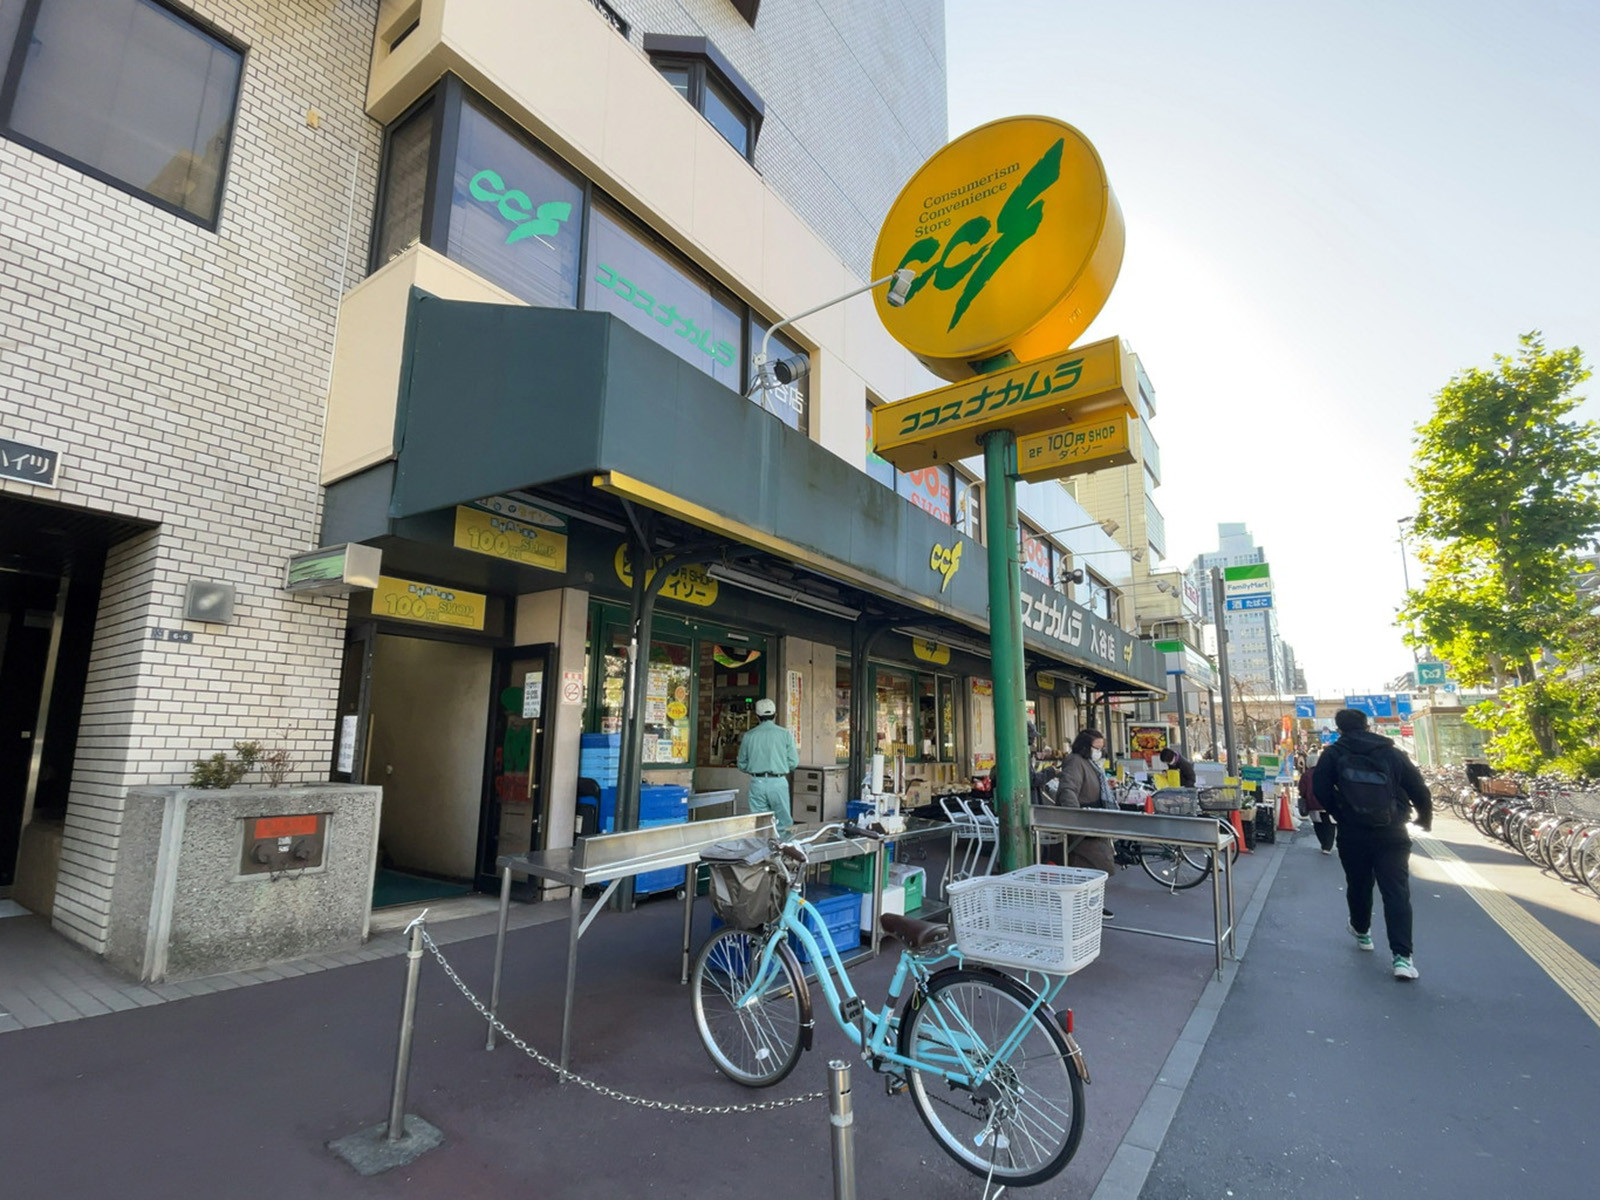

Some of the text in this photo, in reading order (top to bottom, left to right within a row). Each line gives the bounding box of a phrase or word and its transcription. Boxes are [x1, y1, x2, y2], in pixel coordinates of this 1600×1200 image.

[919, 182, 1007, 224] Convenience
[923, 162, 1020, 209] Consumerism
[915, 218, 951, 238] Store
[595, 263, 737, 368] ココスナカムラ
[899, 358, 1085, 435] ココスナカムラ
[1029, 425, 1116, 458] 2F 100円 SHOP
[1058, 444, 1103, 460] ダイソー
[1227, 581, 1269, 591] FamilyMart
